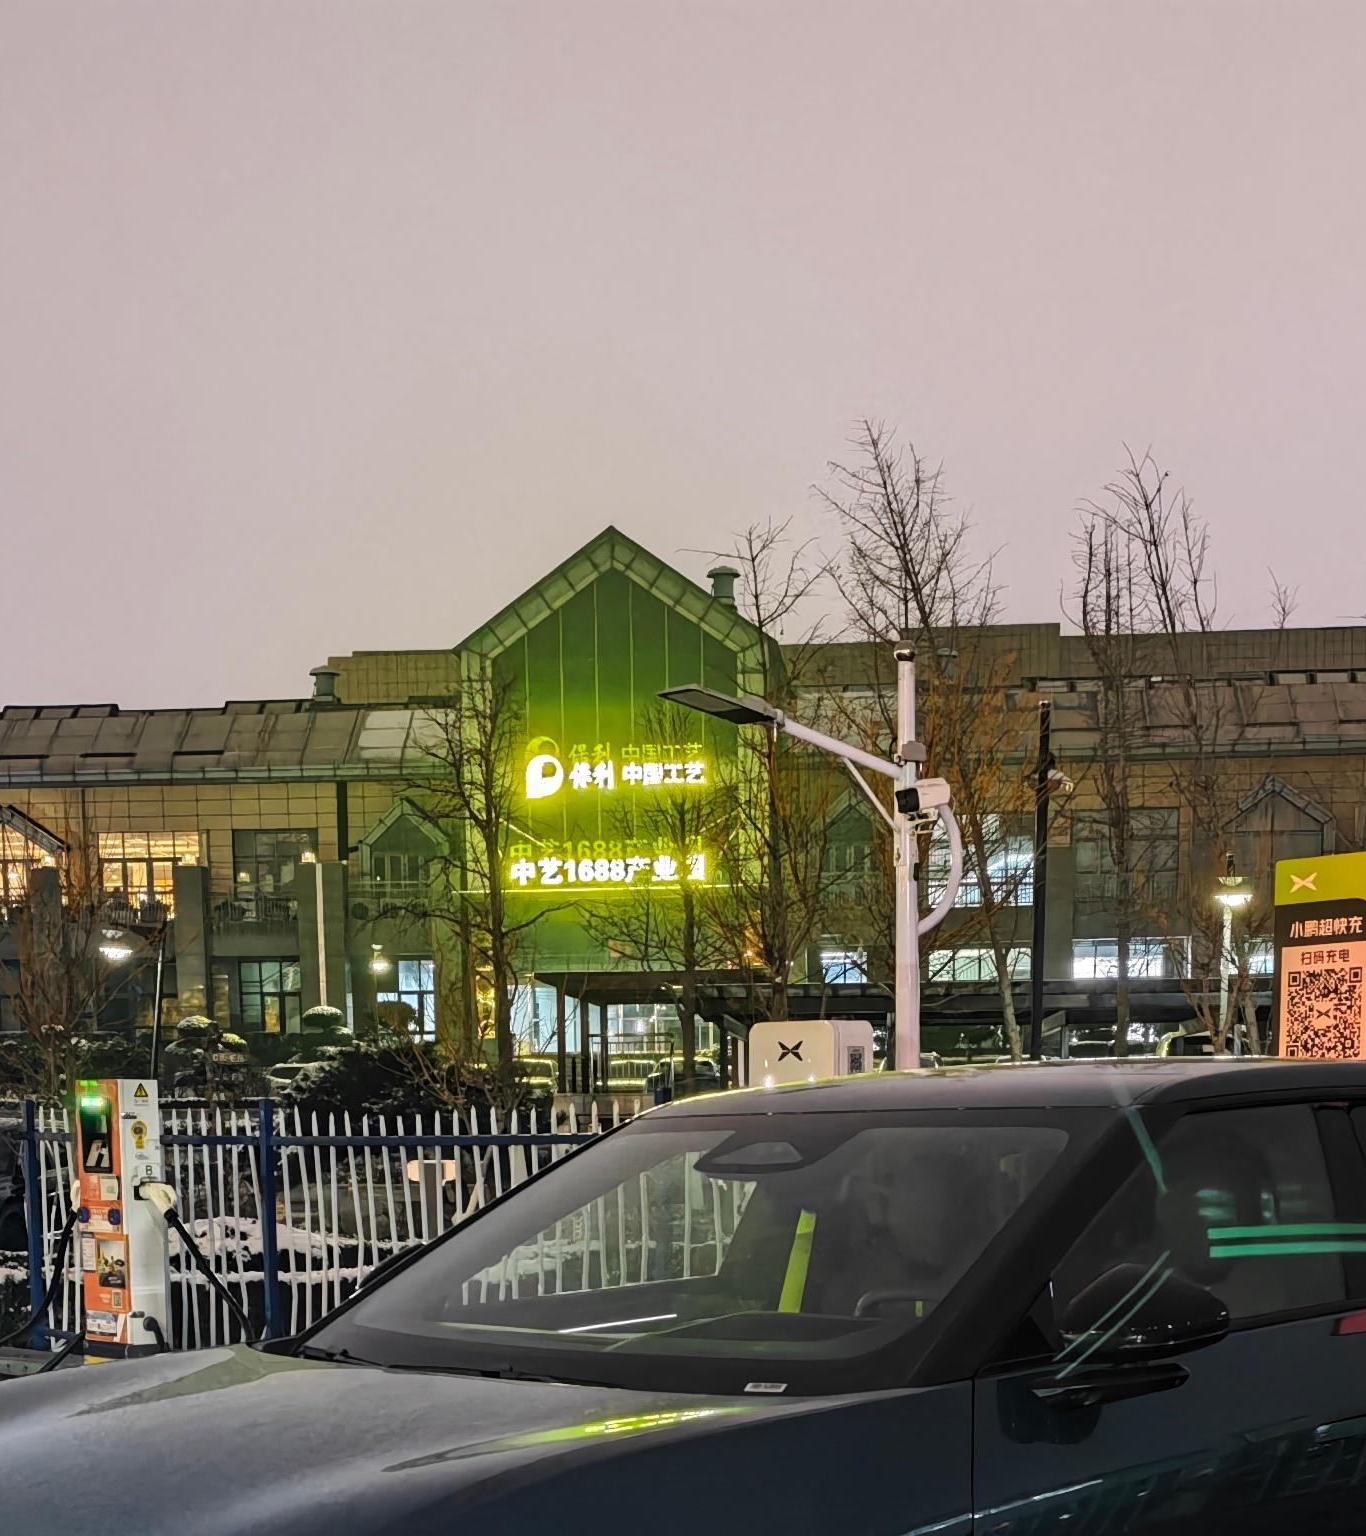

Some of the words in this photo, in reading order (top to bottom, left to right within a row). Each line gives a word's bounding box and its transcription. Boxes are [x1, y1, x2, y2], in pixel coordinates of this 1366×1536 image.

[1289, 916, 1363, 939] 小鹏超快充
[1301, 949, 1350, 966] 扫码充电
